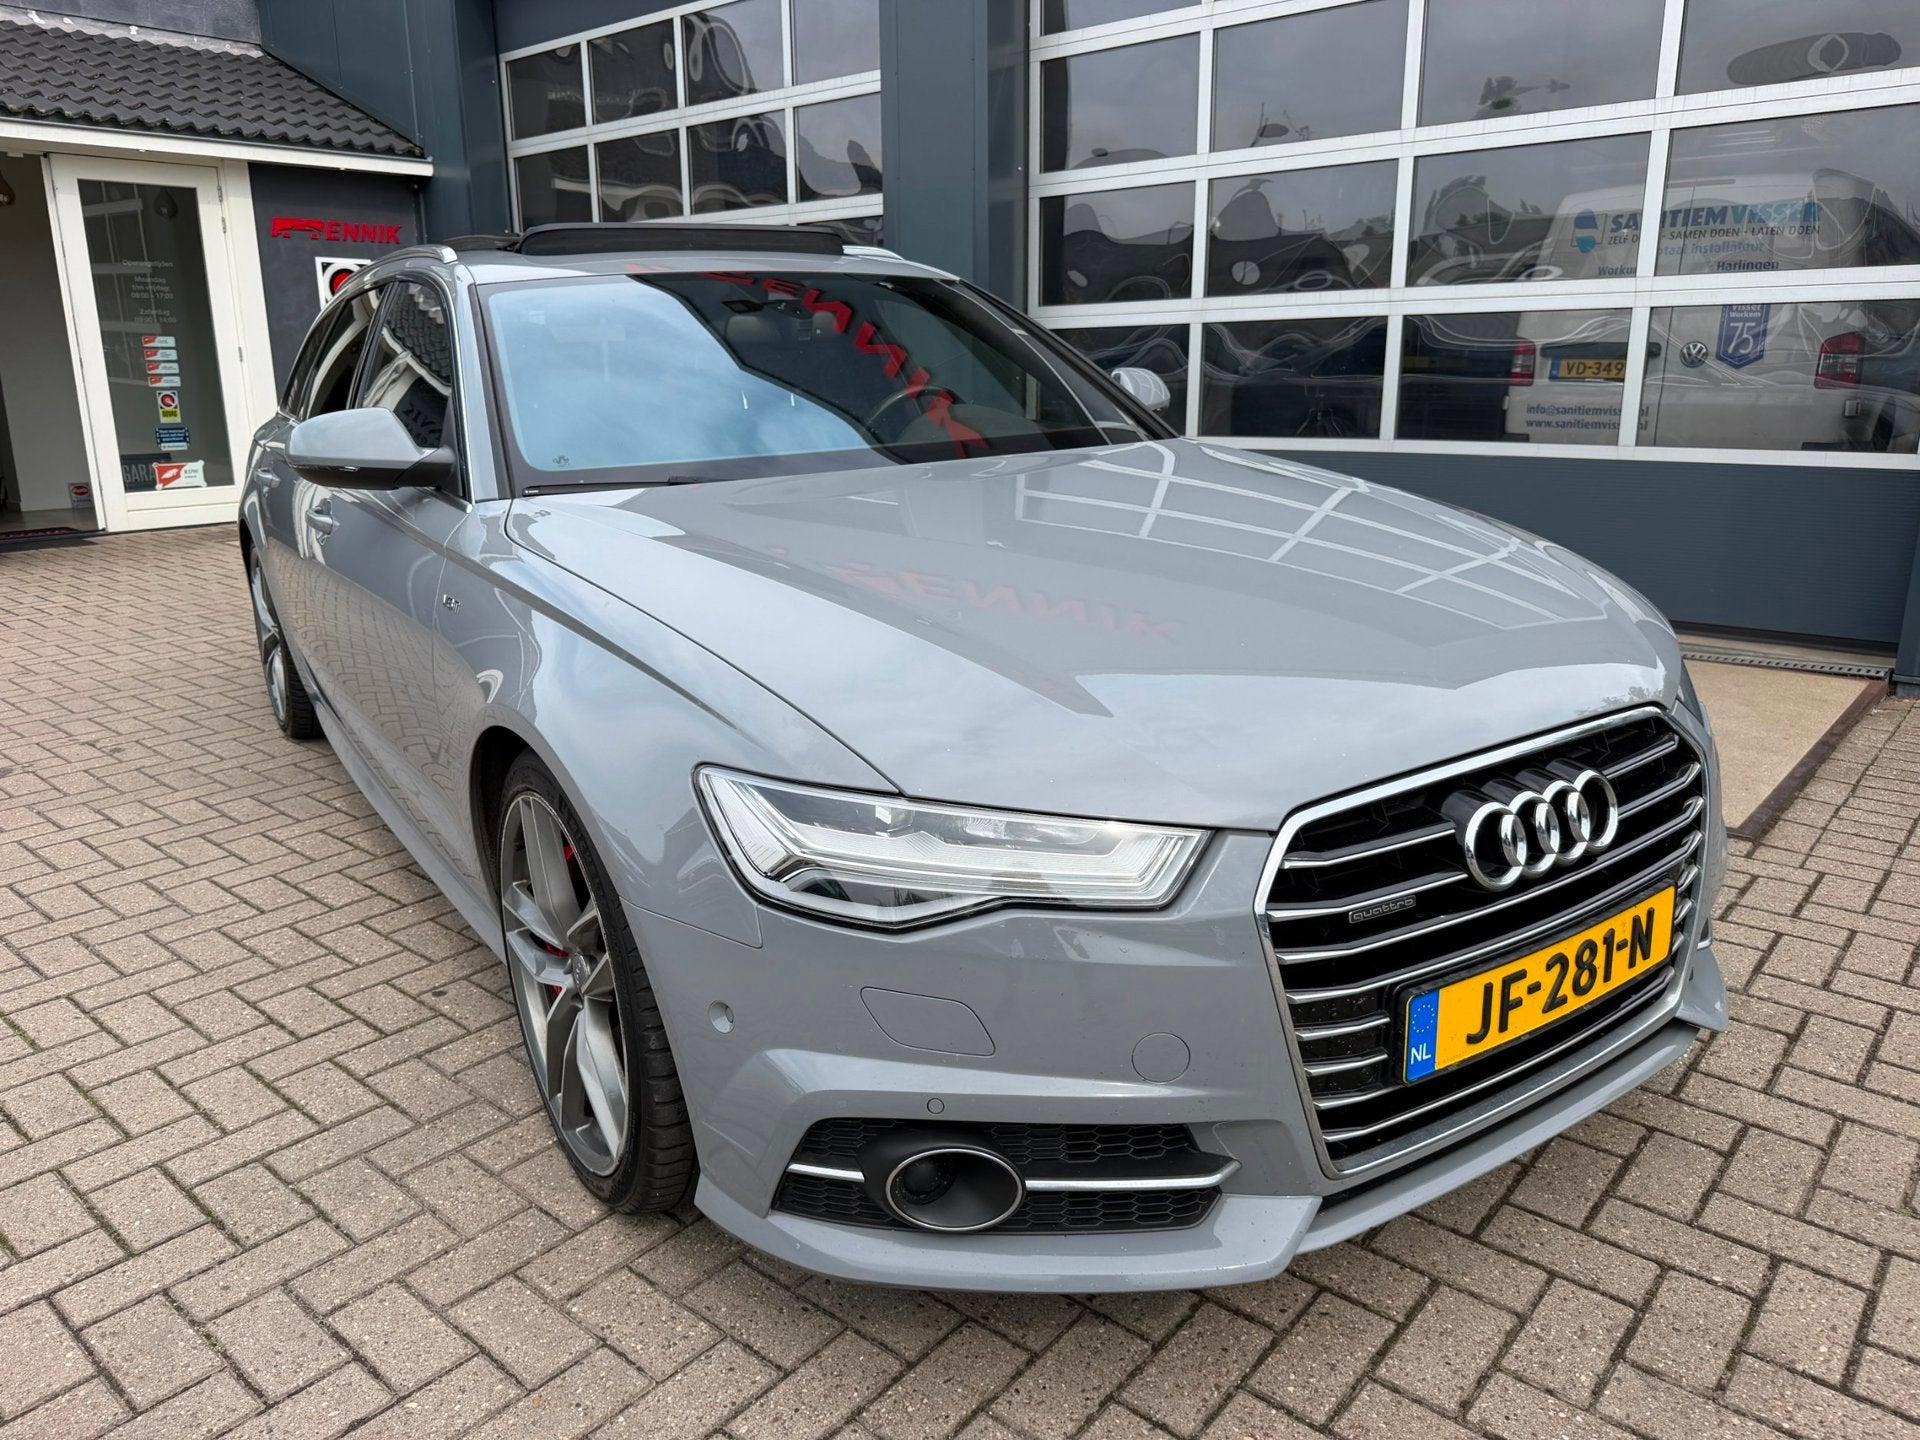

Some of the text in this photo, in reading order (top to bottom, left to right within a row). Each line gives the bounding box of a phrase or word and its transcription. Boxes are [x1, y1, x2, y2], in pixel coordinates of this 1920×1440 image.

[1610, 207, 1728, 233] SAITIEM
[1668, 228, 1707, 241] SAMEN
[1710, 227, 1740, 239] DOEN
[1751, 225, 1786, 237] LATEN
[1788, 222, 1821, 236] DOEN
[1727, 321, 1755, 355] 75
[1352, 898, 1415, 921] quattro
[1410, 906, 1656, 1065] NL JF-281-N
